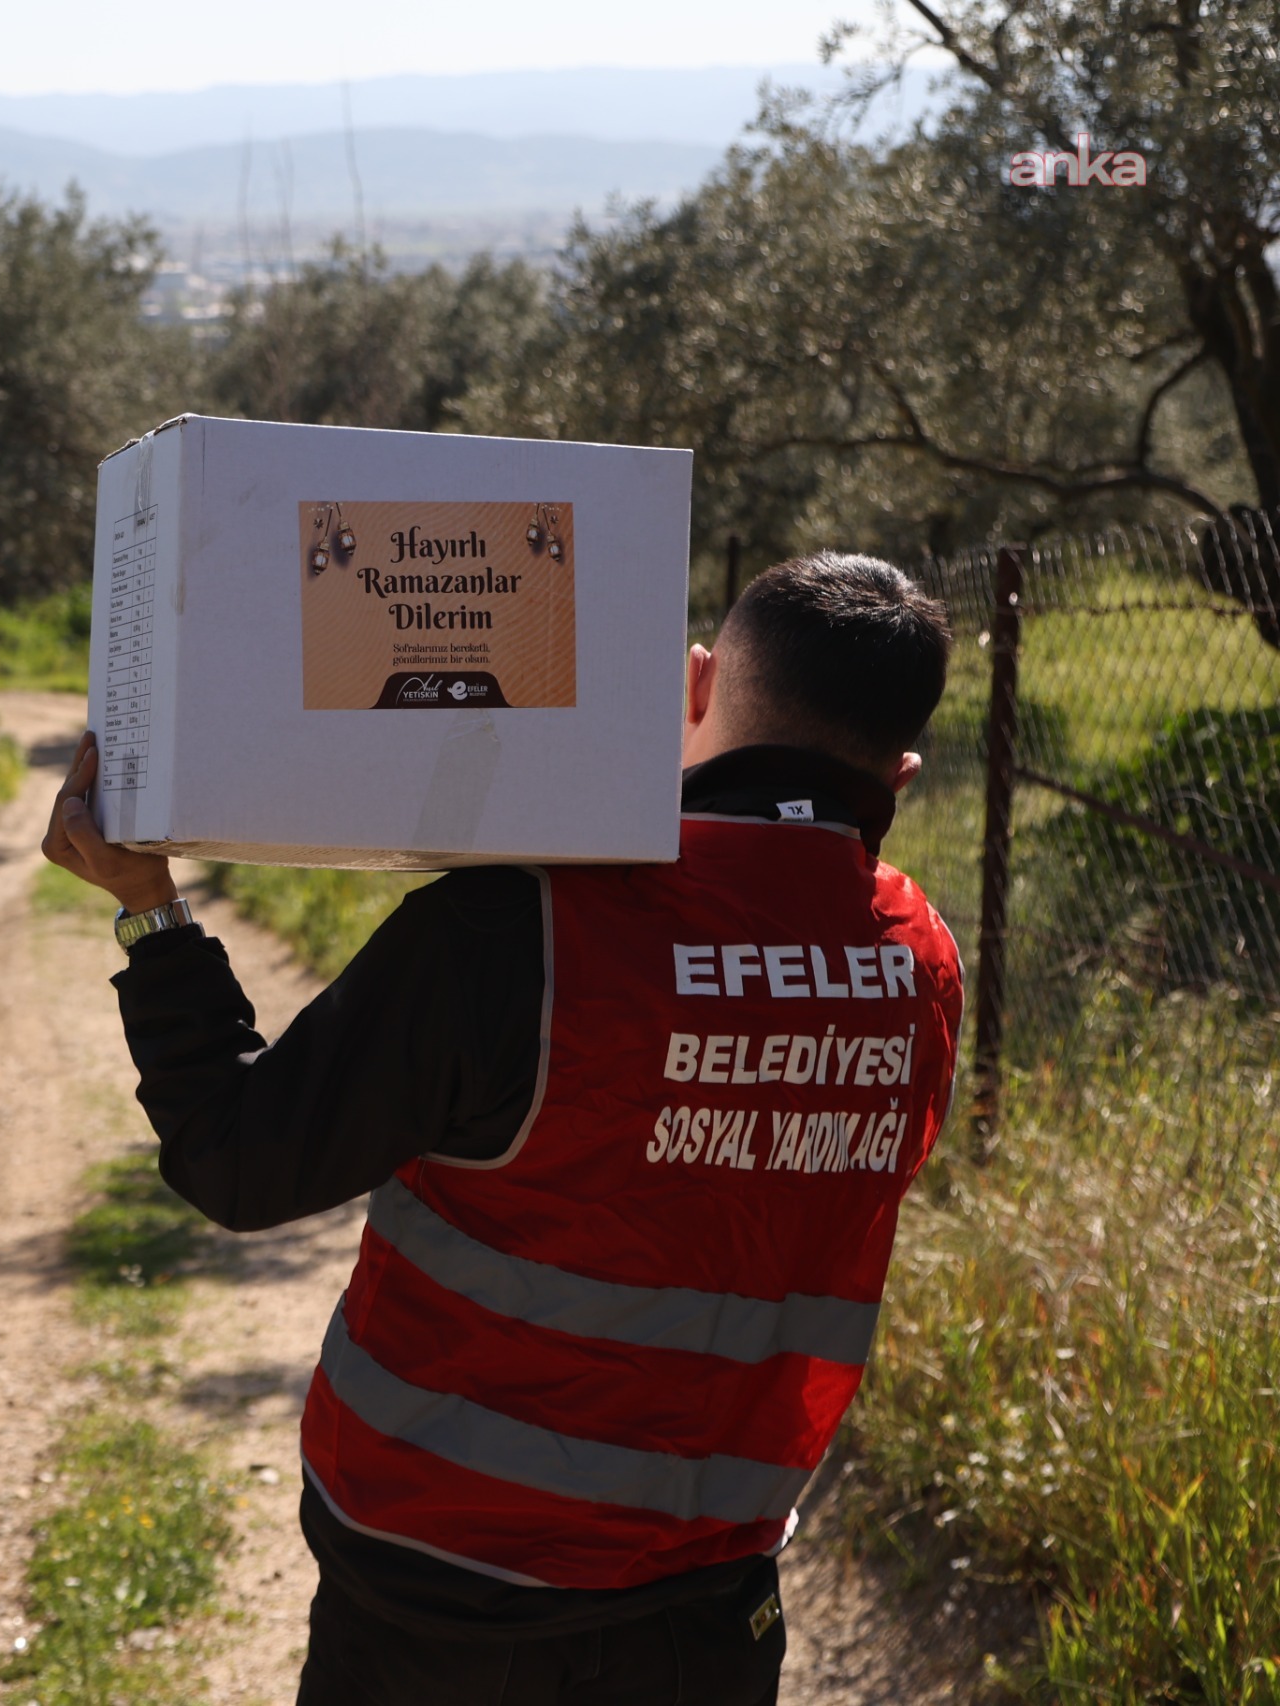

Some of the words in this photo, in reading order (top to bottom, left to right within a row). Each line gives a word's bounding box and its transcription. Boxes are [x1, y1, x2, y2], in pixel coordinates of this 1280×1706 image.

[390, 525, 487, 565] Hayırlı
[357, 567, 523, 599] Ramazanlar
[388, 602, 493, 630] Dilerim
[392, 654, 448, 667] gönüllerimiz
[450, 654, 463, 664] bir
[393, 642, 448, 653] Sofralarımız
[673, 943, 917, 999] EFELER
[663, 1023, 916, 1087] BELEDİYESİ
[646, 1105, 759, 1171] SOSYAL
[765, 1110, 862, 1174] YARDIM
[850, 1097, 908, 1174] AĞI
